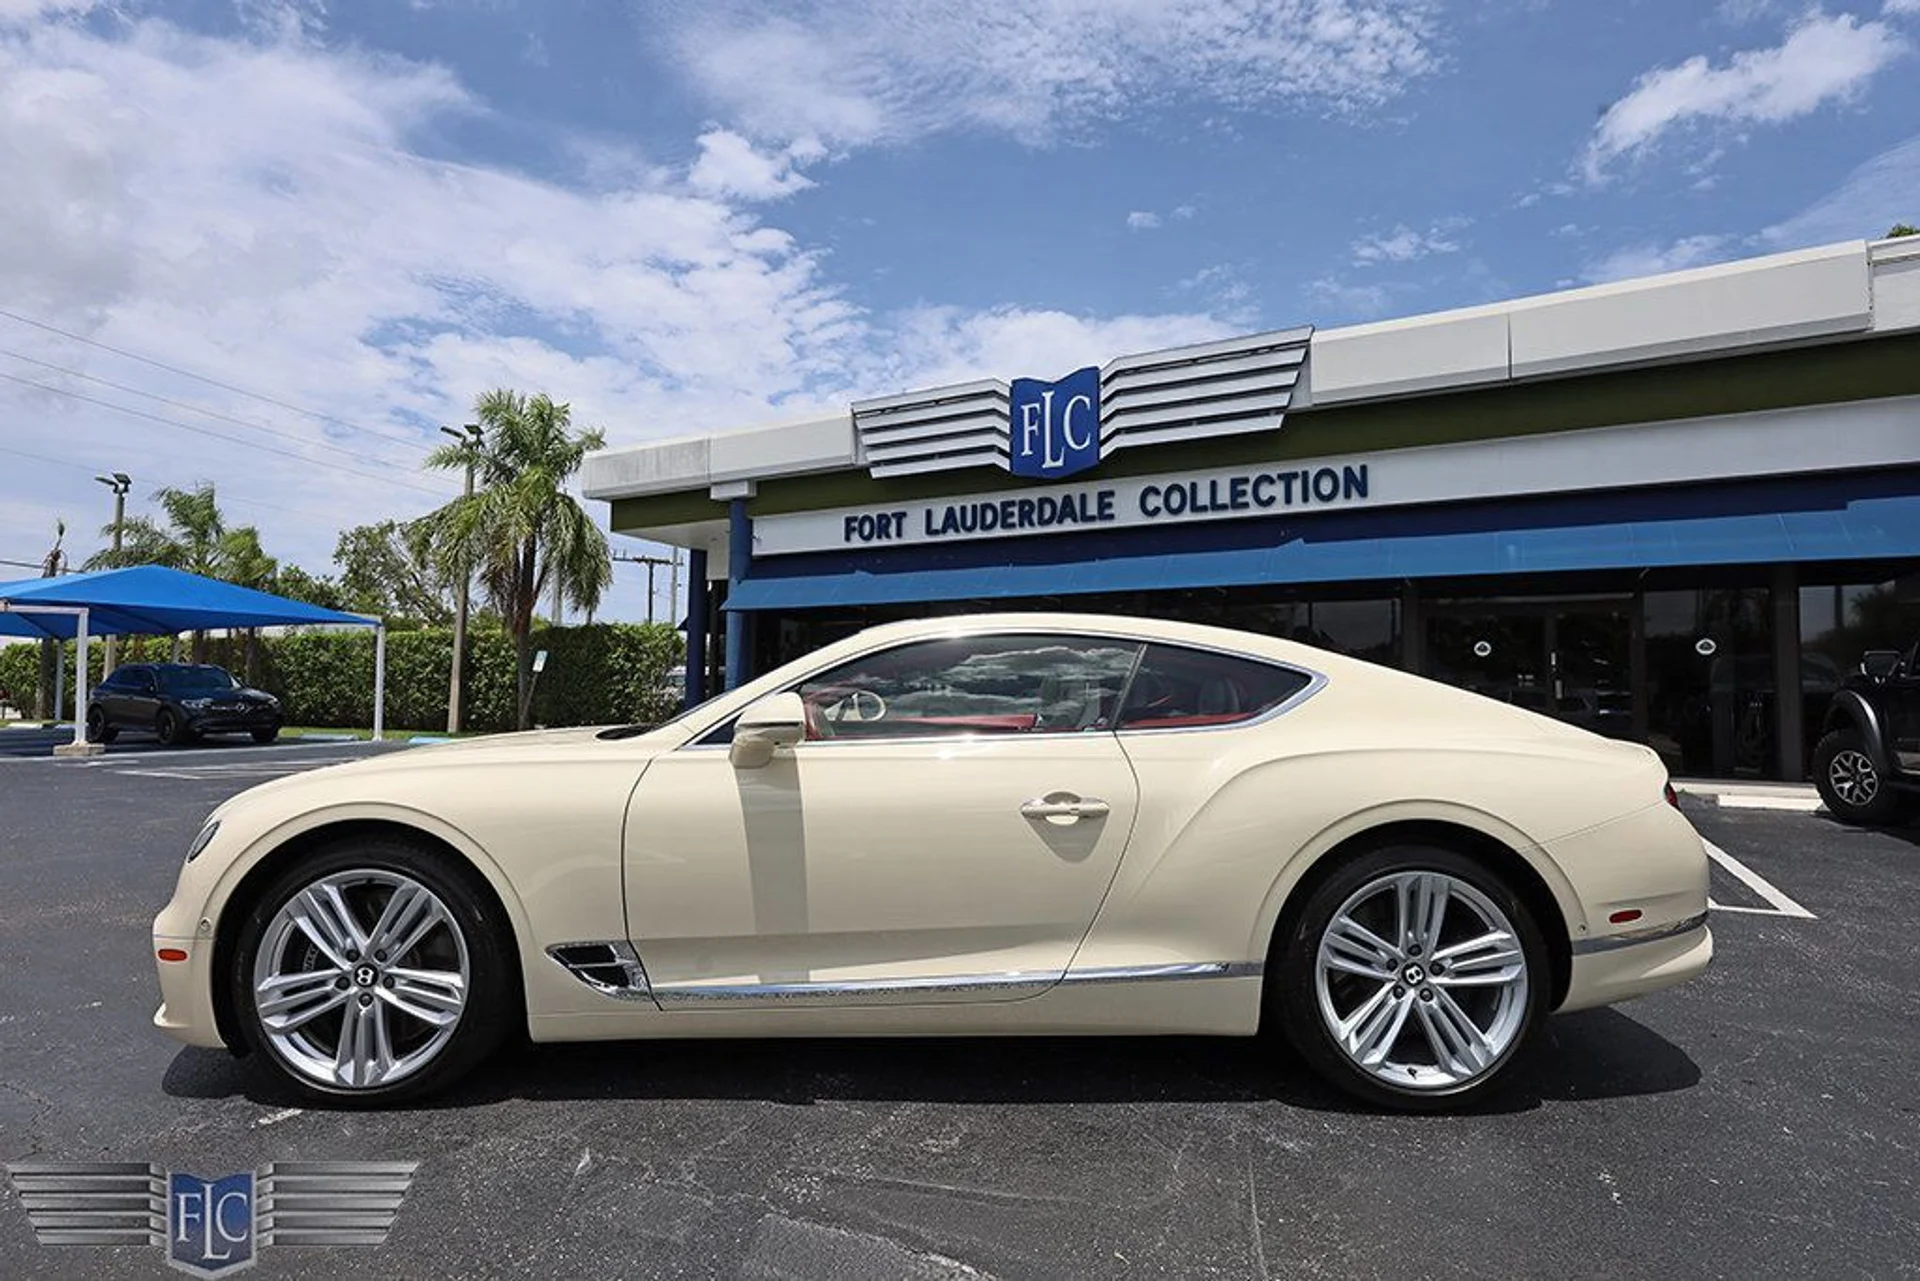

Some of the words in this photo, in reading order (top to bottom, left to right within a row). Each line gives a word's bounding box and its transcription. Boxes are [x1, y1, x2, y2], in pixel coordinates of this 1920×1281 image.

[1020, 390, 1091, 469] FLC
[844, 510, 907, 543] FORT
[925, 490, 1115, 537] LAUDERDALE
[1140, 464, 1368, 518] COLLECTION
